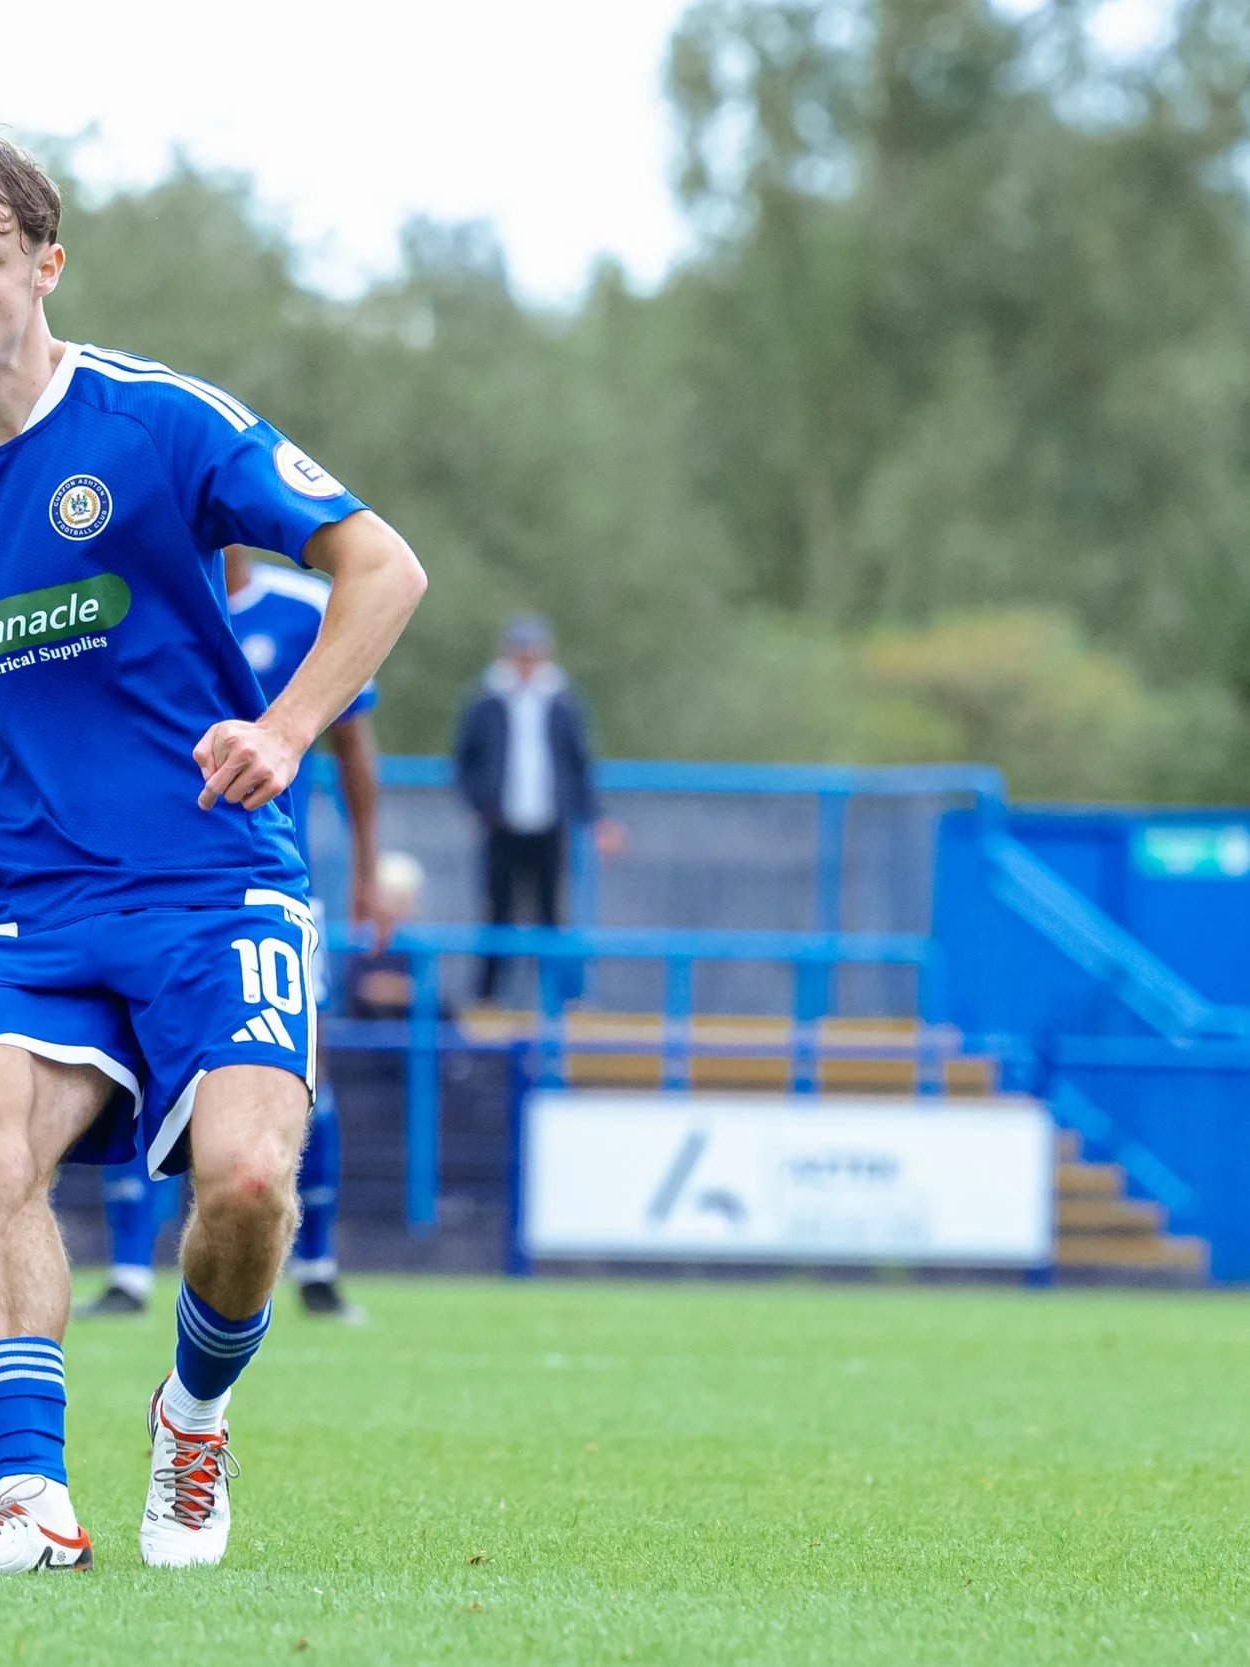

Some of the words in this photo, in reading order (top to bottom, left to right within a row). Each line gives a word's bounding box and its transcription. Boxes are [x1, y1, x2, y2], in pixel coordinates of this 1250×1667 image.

[53, 481, 76, 507] CURZON
[78, 479, 106, 497] ASHTON
[56, 520, 93, 536] FOOTBALL
[93, 510, 107, 529] CLUB
[40, 635, 108, 662] Supplies
[230, 937, 303, 1016] 10
